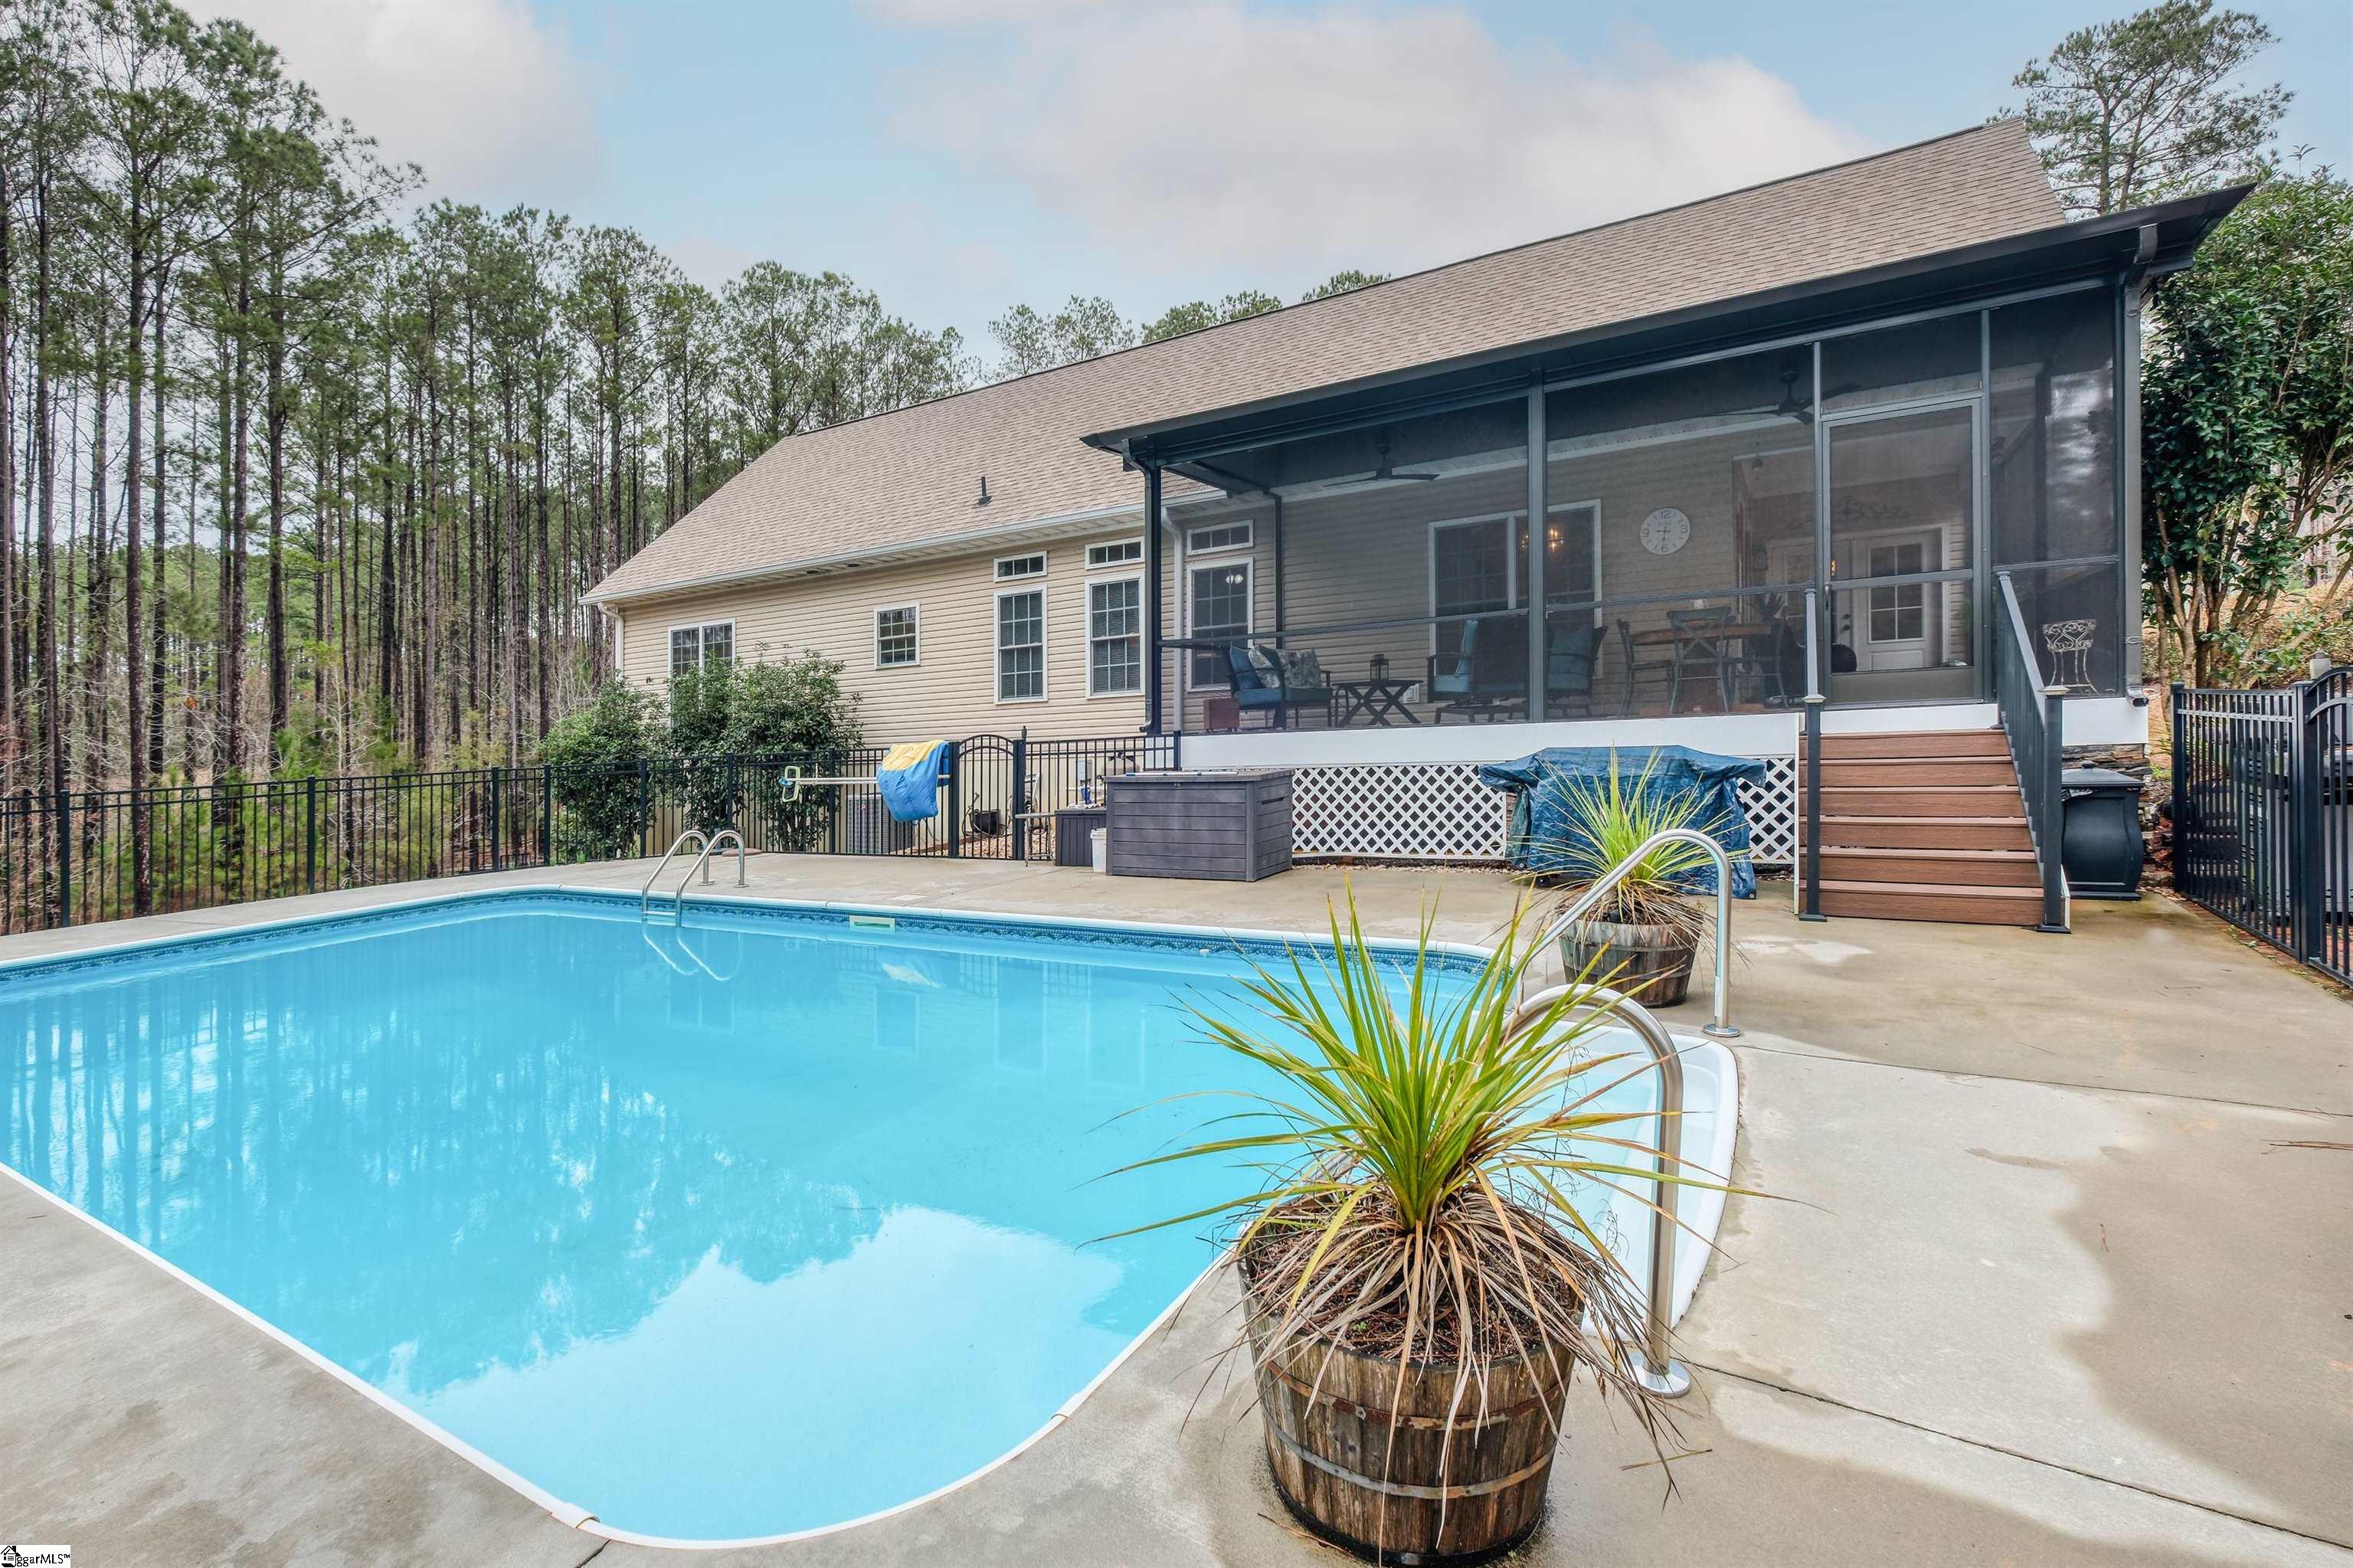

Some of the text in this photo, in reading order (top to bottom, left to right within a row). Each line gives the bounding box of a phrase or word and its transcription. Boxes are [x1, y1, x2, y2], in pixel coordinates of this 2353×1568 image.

[1661, 510, 1671, 519] 12
[1680, 524, 1688, 533] 3
[1661, 544, 1668, 552] 6
